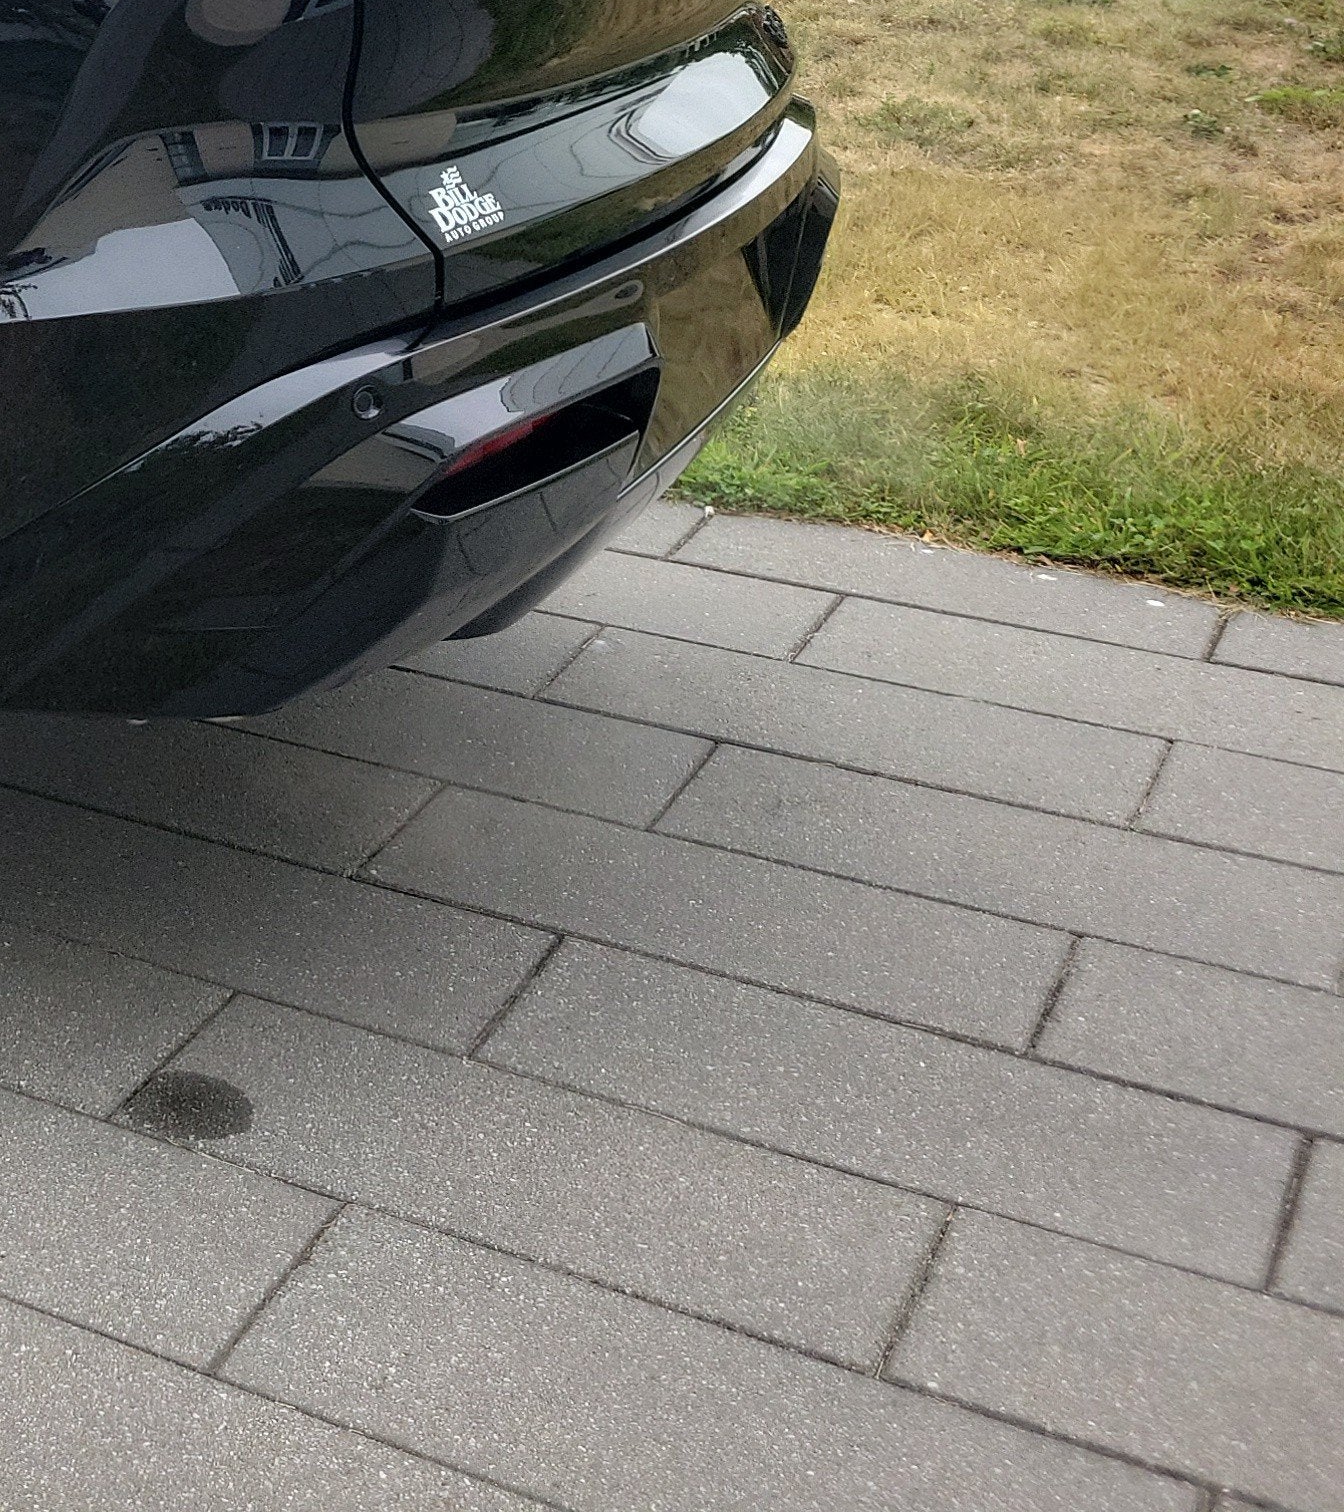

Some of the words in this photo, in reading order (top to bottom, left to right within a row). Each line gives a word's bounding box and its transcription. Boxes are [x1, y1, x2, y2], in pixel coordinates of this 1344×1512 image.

[428, 183, 478, 209] BILL
[428, 193, 502, 233] DODGE
[444, 225, 472, 243] AUTO
[472, 211, 505, 231] GROUP
